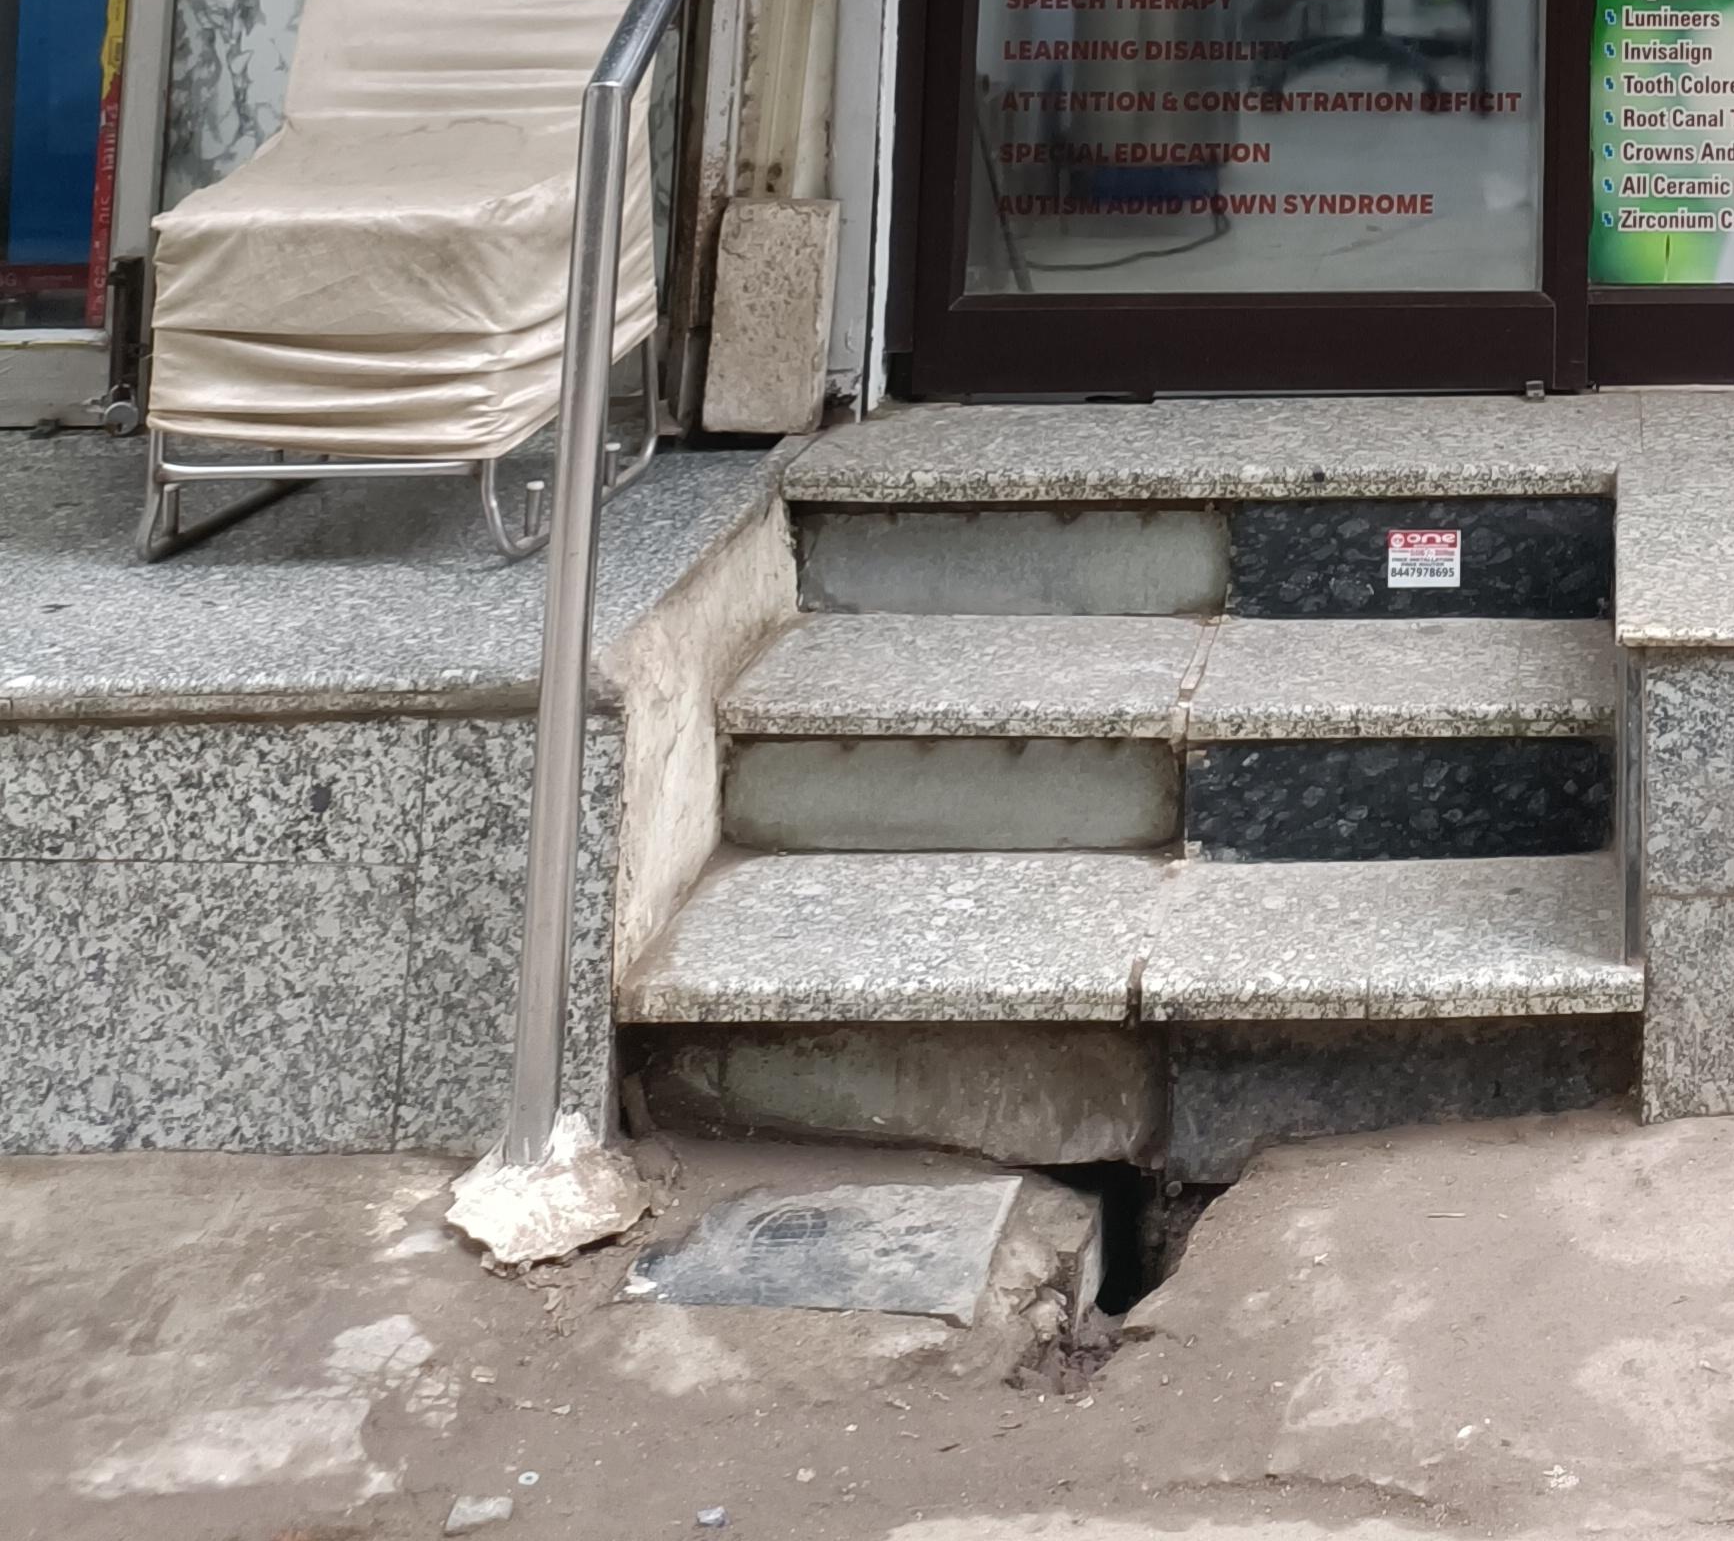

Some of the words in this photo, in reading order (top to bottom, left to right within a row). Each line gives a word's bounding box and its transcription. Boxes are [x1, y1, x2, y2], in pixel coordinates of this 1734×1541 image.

[1624, 9, 1720, 29] Lumineers
[1003, 40, 1139, 62] LEARNING
[1144, 41, 1292, 62] DISABILITY
[1624, 43, 1713, 65] Invisalign
[1624, 77, 1675, 95] Tooth
[1002, 91, 1157, 113] ATTENTION
[1162, 92, 1178, 113] &
[1182, 92, 1414, 113] CONCENTRATION
[1420, 92, 1523, 113] DEFICIT
[1623, 110, 1667, 129] Root
[1672, 110, 1725, 129] Canal
[1000, 143, 1109, 164] SPECIAL
[1114, 143, 1272, 164] EDUCATION
[1623, 143, 1695, 163] Crowns
[1623, 177, 1648, 196] All
[1652, 177, 1731, 196] Ceramic
[1189, 194, 1277, 215] DOWN
[1282, 193, 1434, 215] SYNDROME
[1621, 210, 1715, 230] Zirconium
